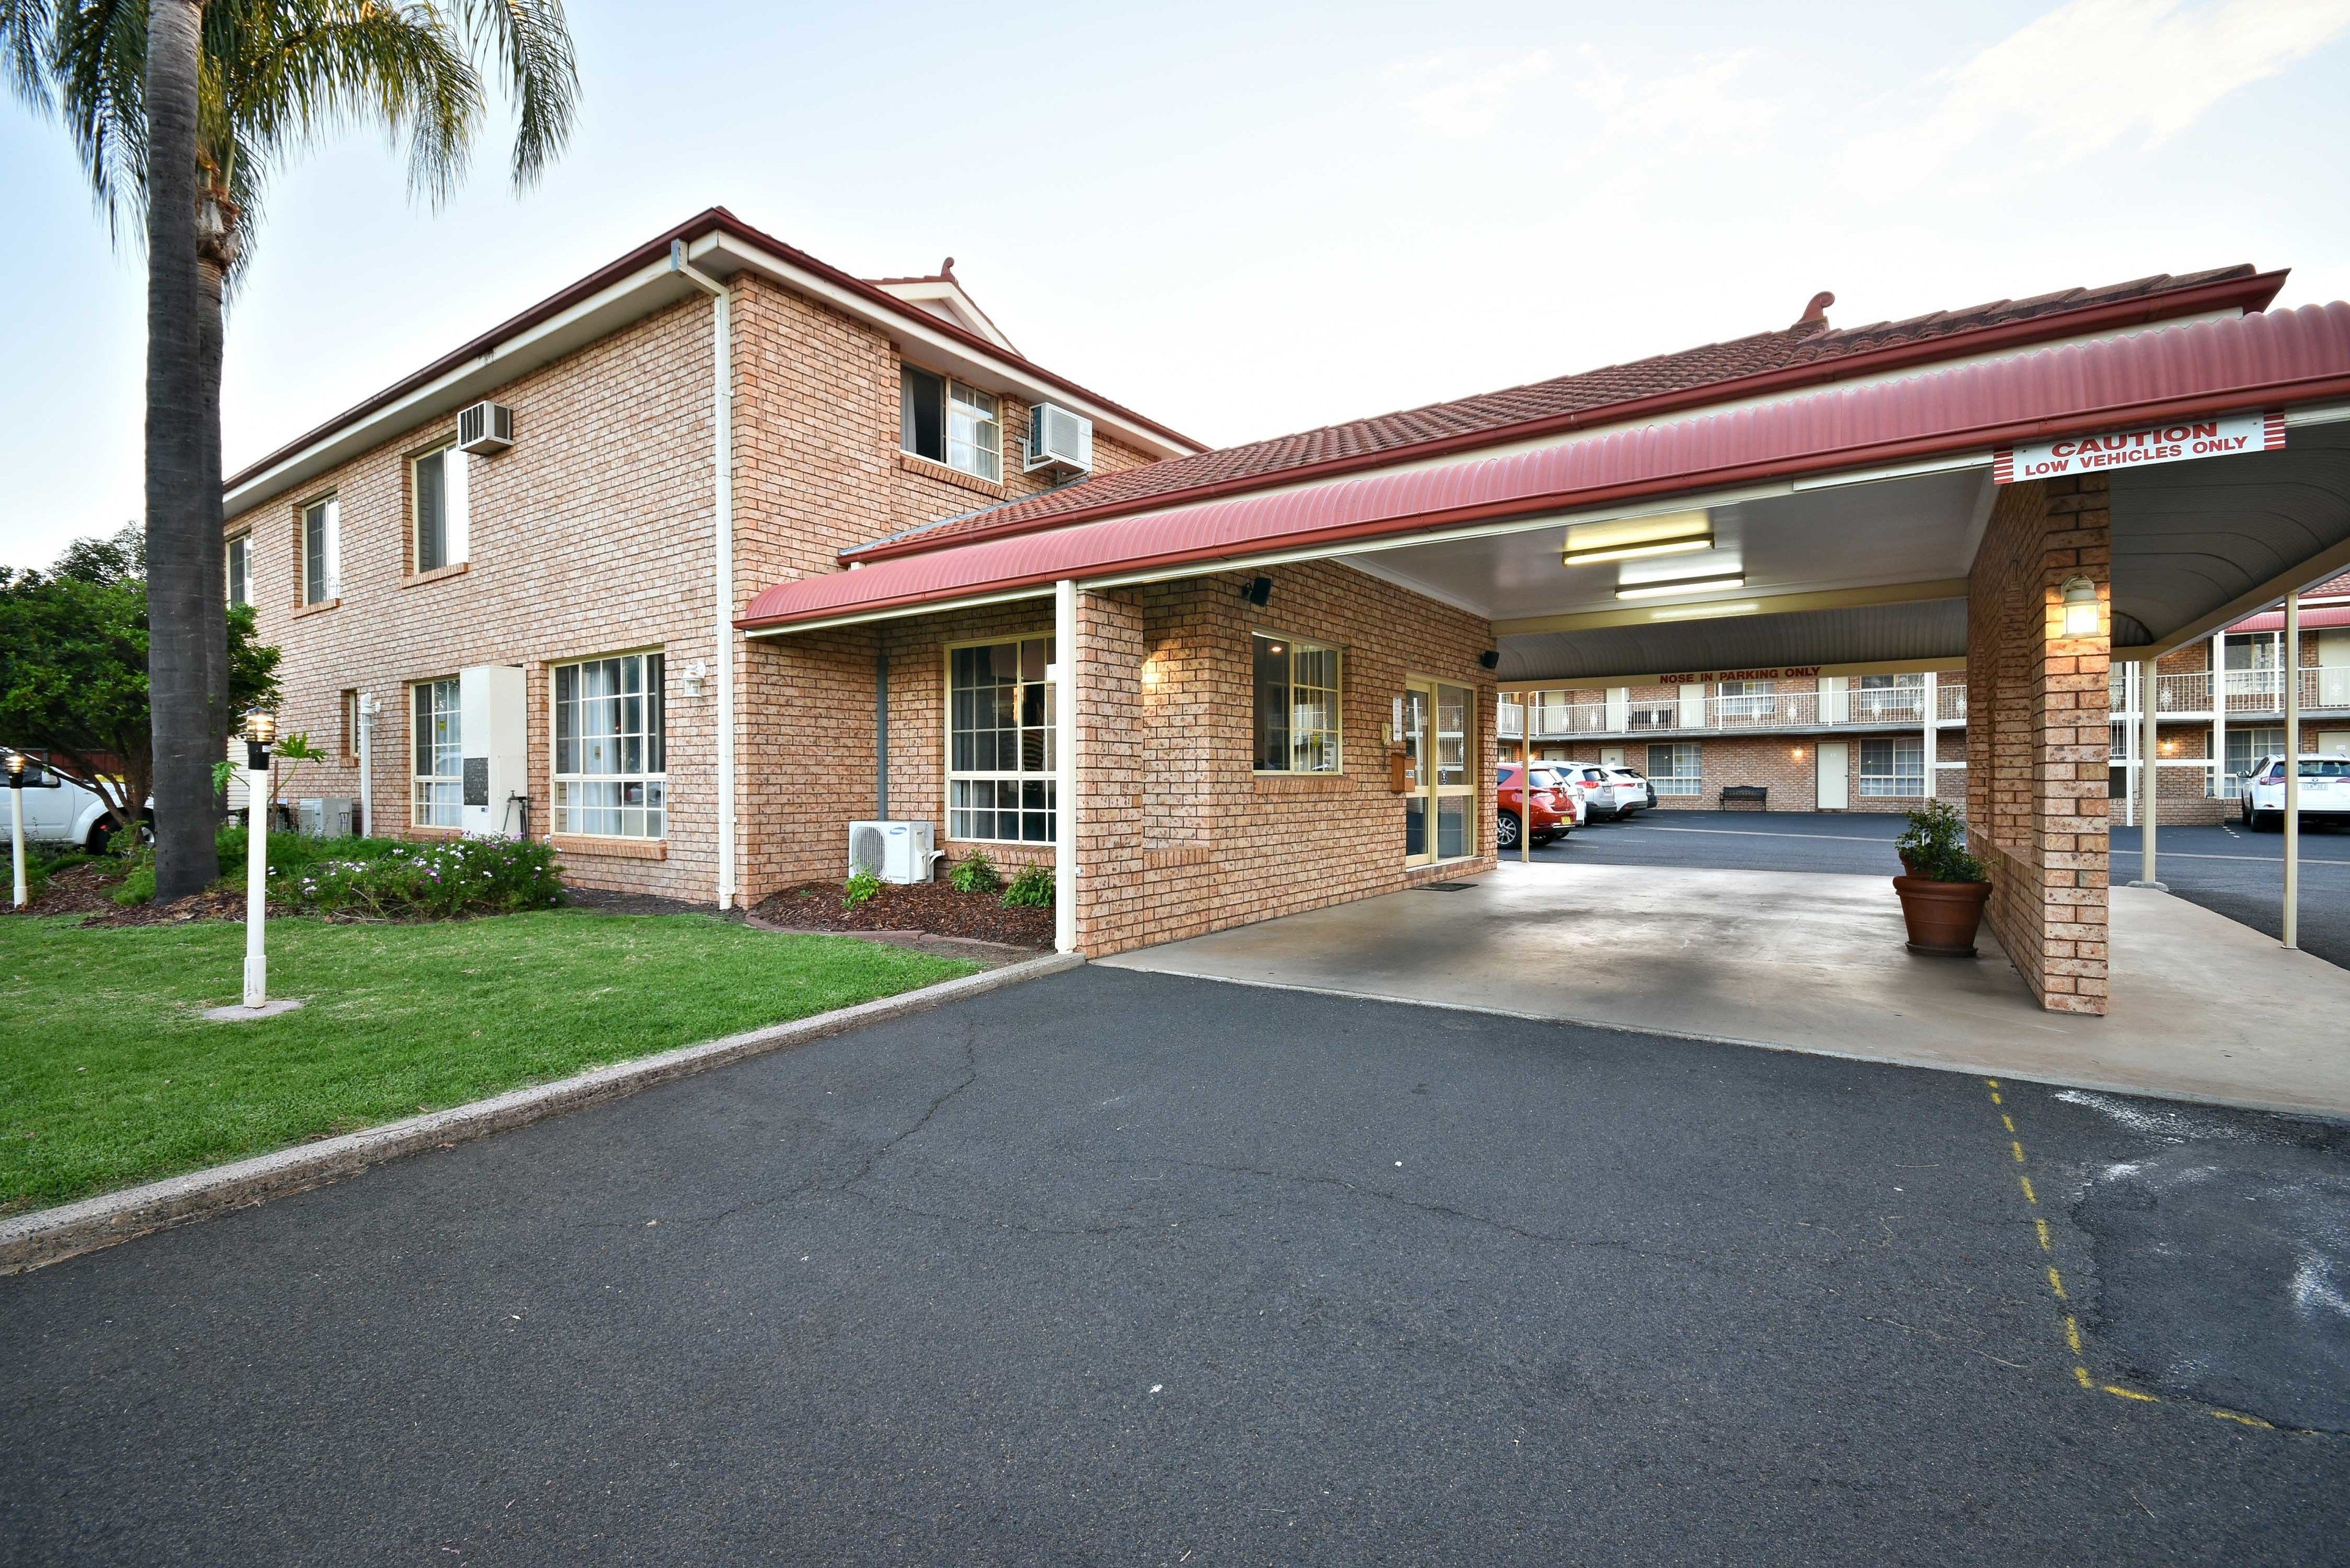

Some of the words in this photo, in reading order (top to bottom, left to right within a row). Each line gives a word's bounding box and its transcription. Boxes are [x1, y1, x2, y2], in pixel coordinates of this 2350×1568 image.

[2026, 460, 2069, 476] LOW
[2080, 444, 2182, 468] VEHICLES
[2192, 436, 2248, 454] ONLY
[2051, 422, 2217, 457] CAUTION
[1660, 674, 1694, 684] NOSE
[1701, 673, 1713, 682] IN
[1720, 670, 1778, 681] PARKING
[1785, 666, 1821, 678] ONLY
